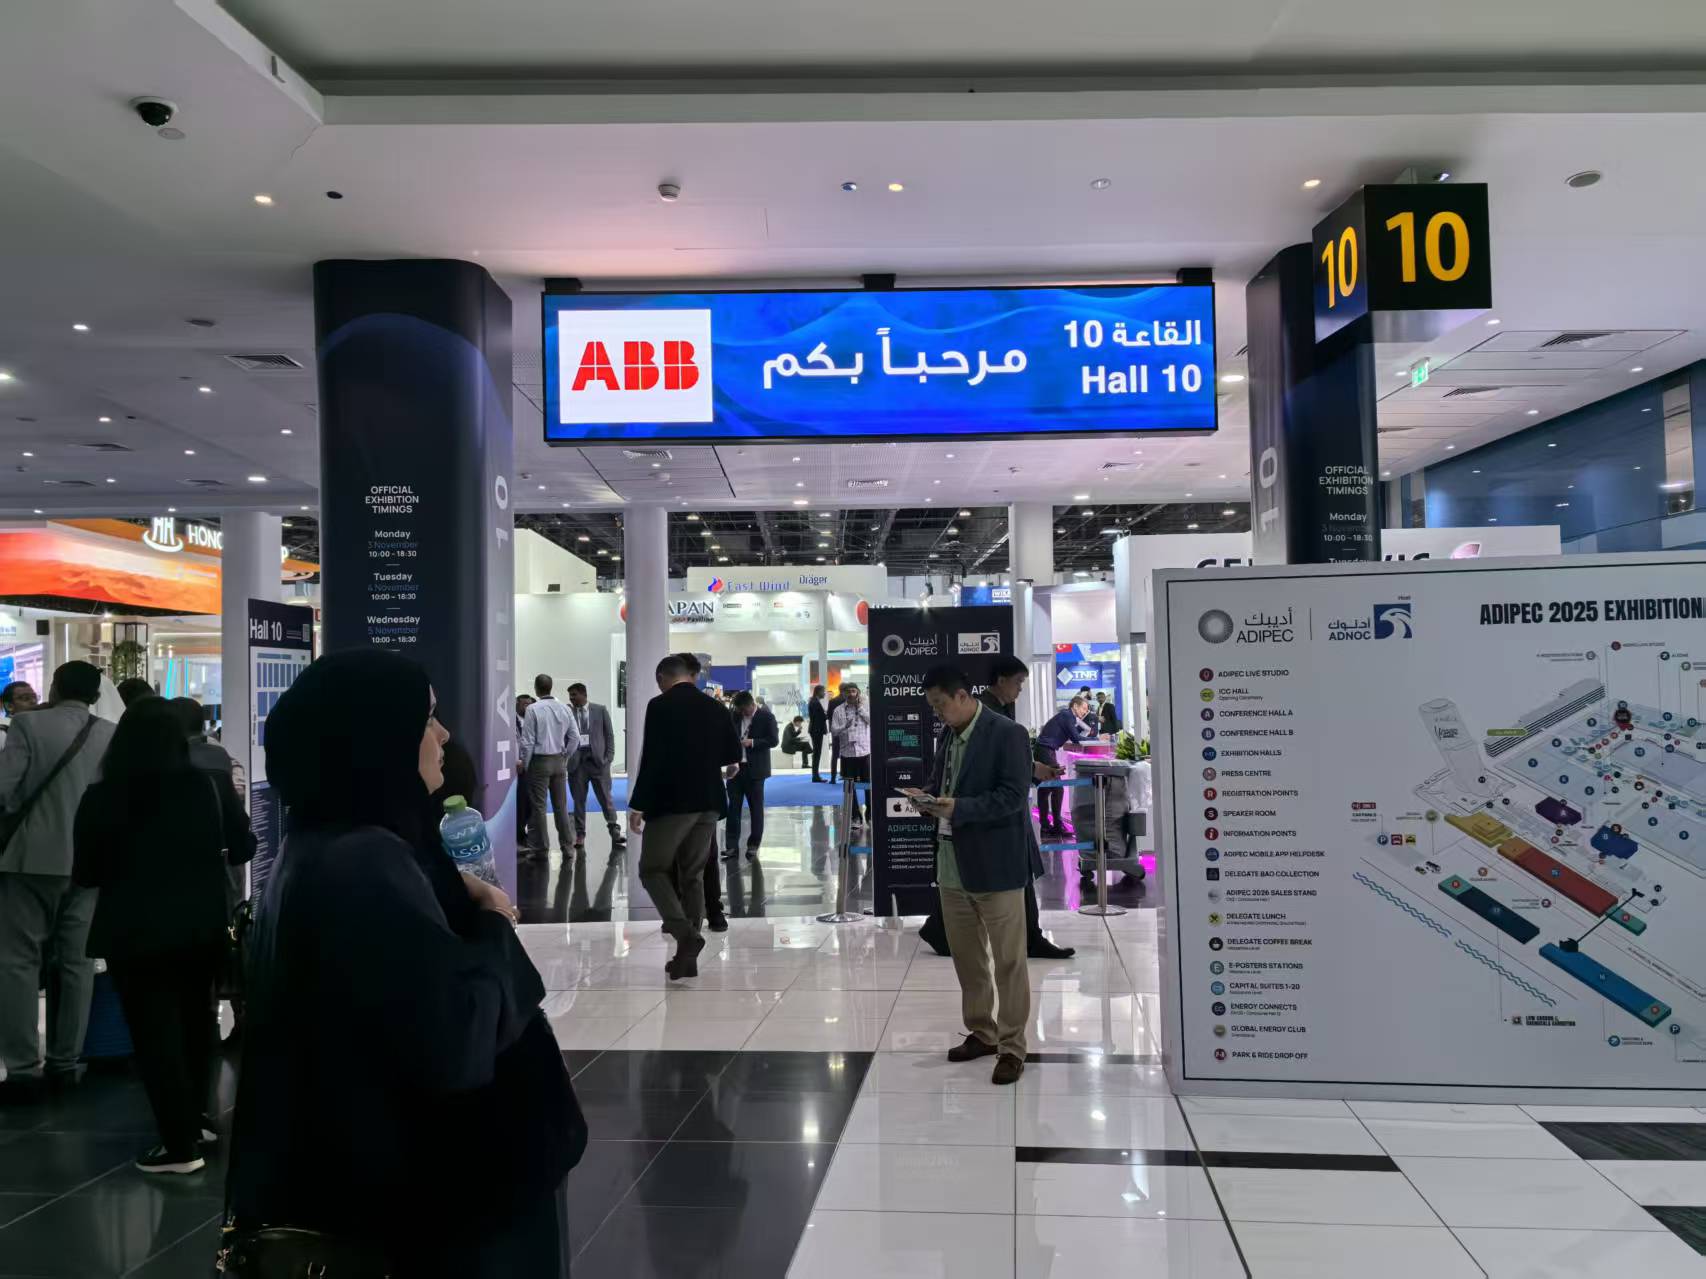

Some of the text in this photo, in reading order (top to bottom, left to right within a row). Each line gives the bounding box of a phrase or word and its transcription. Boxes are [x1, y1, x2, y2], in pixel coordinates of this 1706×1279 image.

[1386, 211, 1470, 283] 10
[1321, 226, 1358, 309] 10
[1064, 318, 1202, 347] القاعة 10
[571, 341, 700, 391] ABB
[763, 340, 864, 388] بكم
[1082, 364, 1202, 394] Hall 10
[1325, 466, 1369, 475] OFFICIAL
[1319, 476, 1374, 485] EXHIBITION
[370, 485, 414, 494] OFFICIAL
[1326, 486, 1369, 495] TIMINGS
[365, 495, 420, 504] EXHIBITION
[371, 505, 413, 514] TIMINGS
[1329, 512, 1368, 522] Monday
[374, 530, 411, 540] Monday
[373, 572, 413, 582] Tuesday
[800, 574, 828, 586] Dräger
[1480, 597, 1704, 625] ADIPEC 2025 EXHIBITION
[367, 616, 420, 624] Wednesday
[250, 618, 268, 640] Hall
[271, 622, 282, 642] 10
[1236, 630, 1294, 643] ADIPEC
[1328, 631, 1372, 640] ADNOC
[904, 647, 938, 656] ADIPEC
[884, 685, 989, 697] ADIPEC AP
